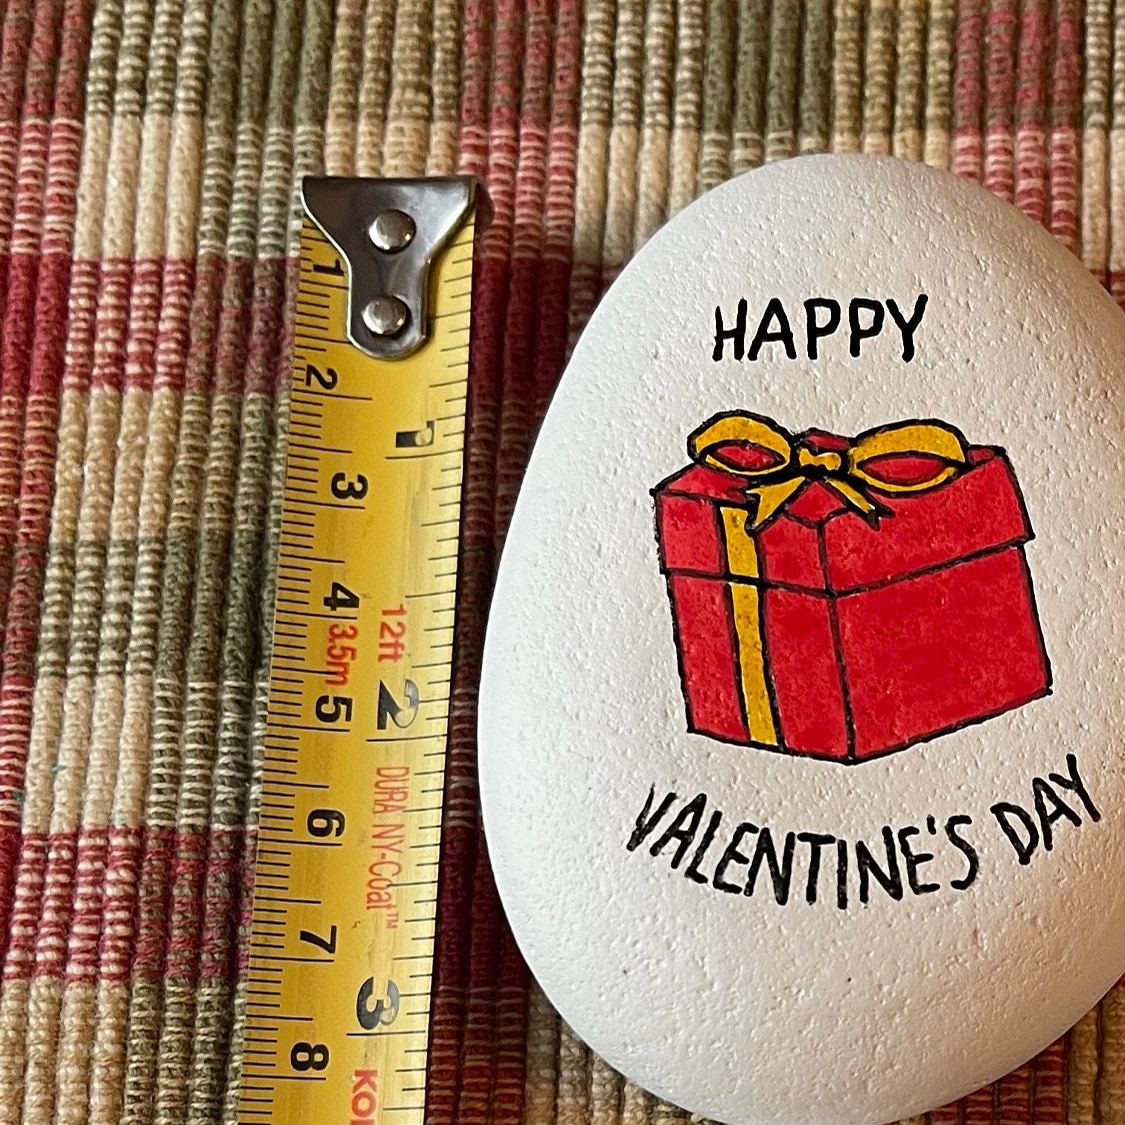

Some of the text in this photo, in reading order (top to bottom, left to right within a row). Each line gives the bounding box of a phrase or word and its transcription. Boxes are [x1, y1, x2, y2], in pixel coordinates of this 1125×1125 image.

[313, 259, 344, 276] 1
[712, 293, 929, 363] HAPPY
[305, 364, 338, 390] 2
[396, 420, 434, 448] 1
[331, 472, 369, 499] 3
[323, 582, 360, 611] 4
[378, 604, 407, 663] 12ft
[325, 623, 358, 686] 3.5m
[316, 695, 353, 722] 5
[376, 679, 420, 730] 2
[372, 766, 410, 814] DURA
[306, 809, 345, 837] 6
[625, 753, 1102, 910] VALENTINE'S DAY
[299, 925, 337, 954] 7
[357, 976, 400, 1030] 3
[290, 1042, 329, 1072] 8
